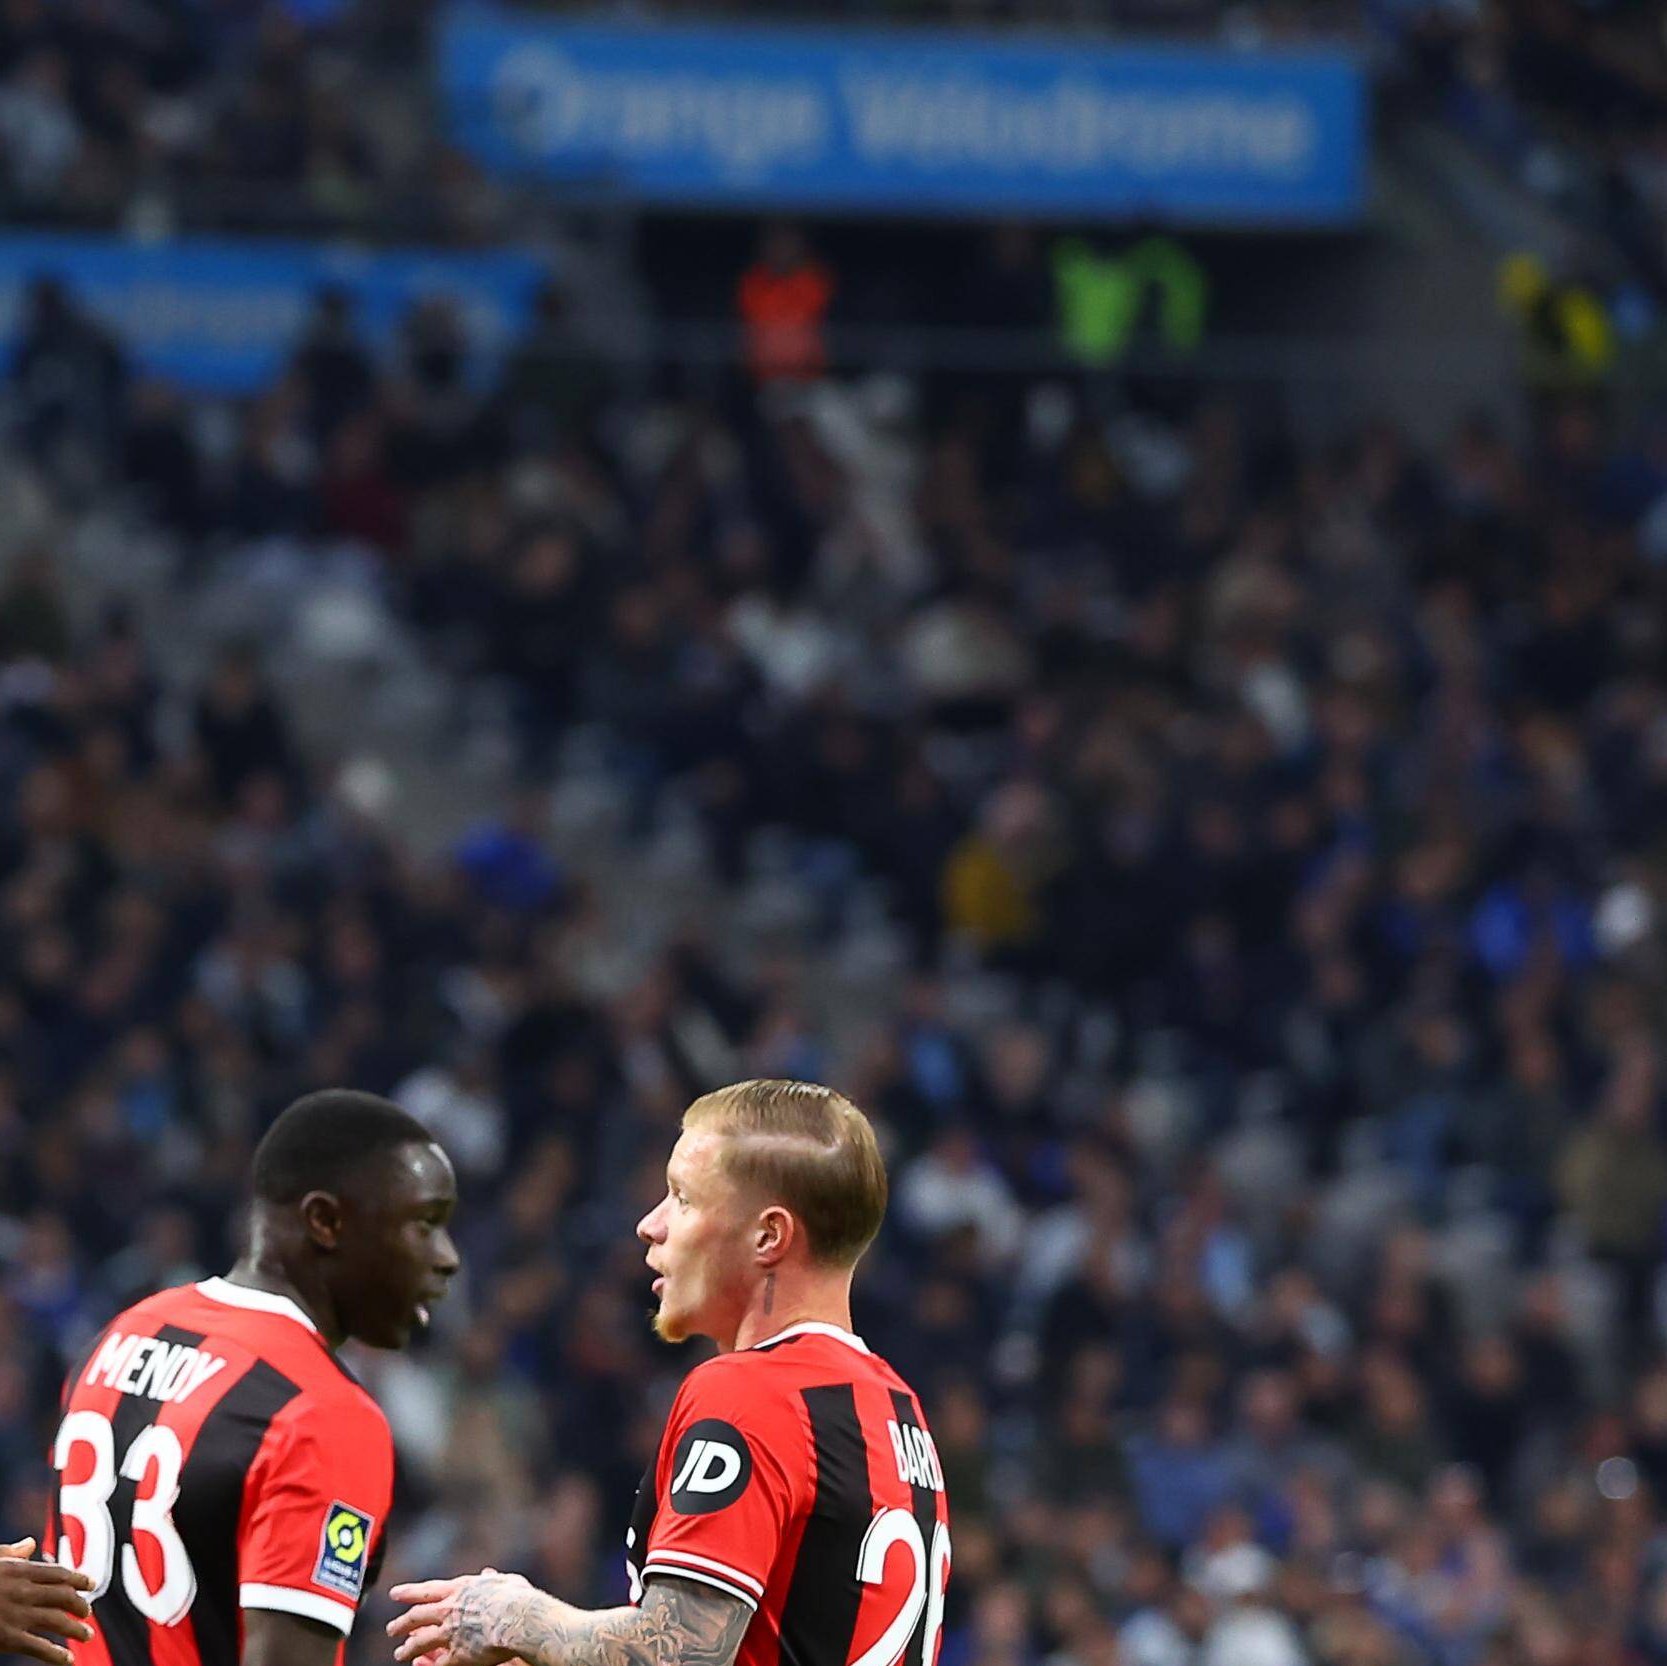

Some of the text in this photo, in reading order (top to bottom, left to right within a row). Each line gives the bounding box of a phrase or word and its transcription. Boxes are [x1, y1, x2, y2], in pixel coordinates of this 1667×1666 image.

[86, 1332, 227, 1404] MENDY
[671, 1440, 741, 1495] JD
[54, 1410, 198, 1627] 33
